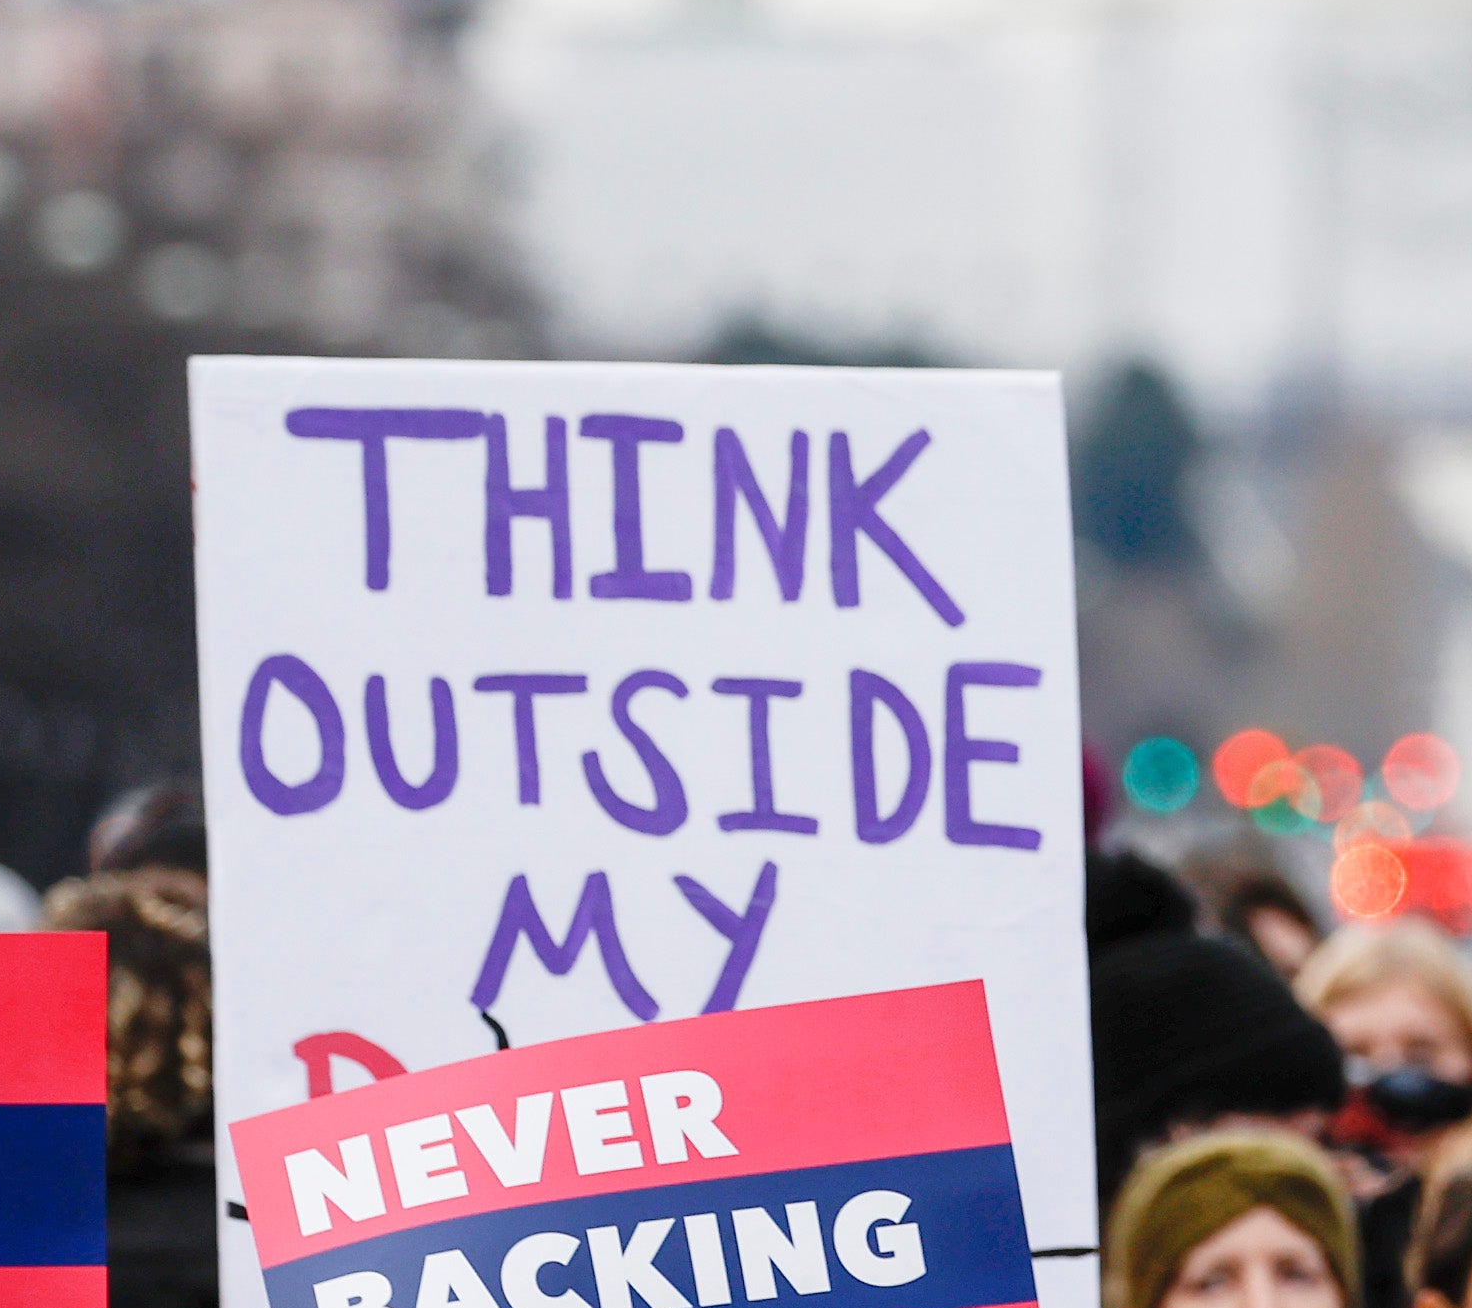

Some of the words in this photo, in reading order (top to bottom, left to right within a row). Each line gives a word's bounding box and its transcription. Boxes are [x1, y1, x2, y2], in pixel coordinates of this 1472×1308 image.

[285, 407, 965, 627] THINK
[240, 654, 1042, 851] OUTSIDE
[470, 861, 777, 1024] MY
[284, 1071, 740, 1237] NEVER
